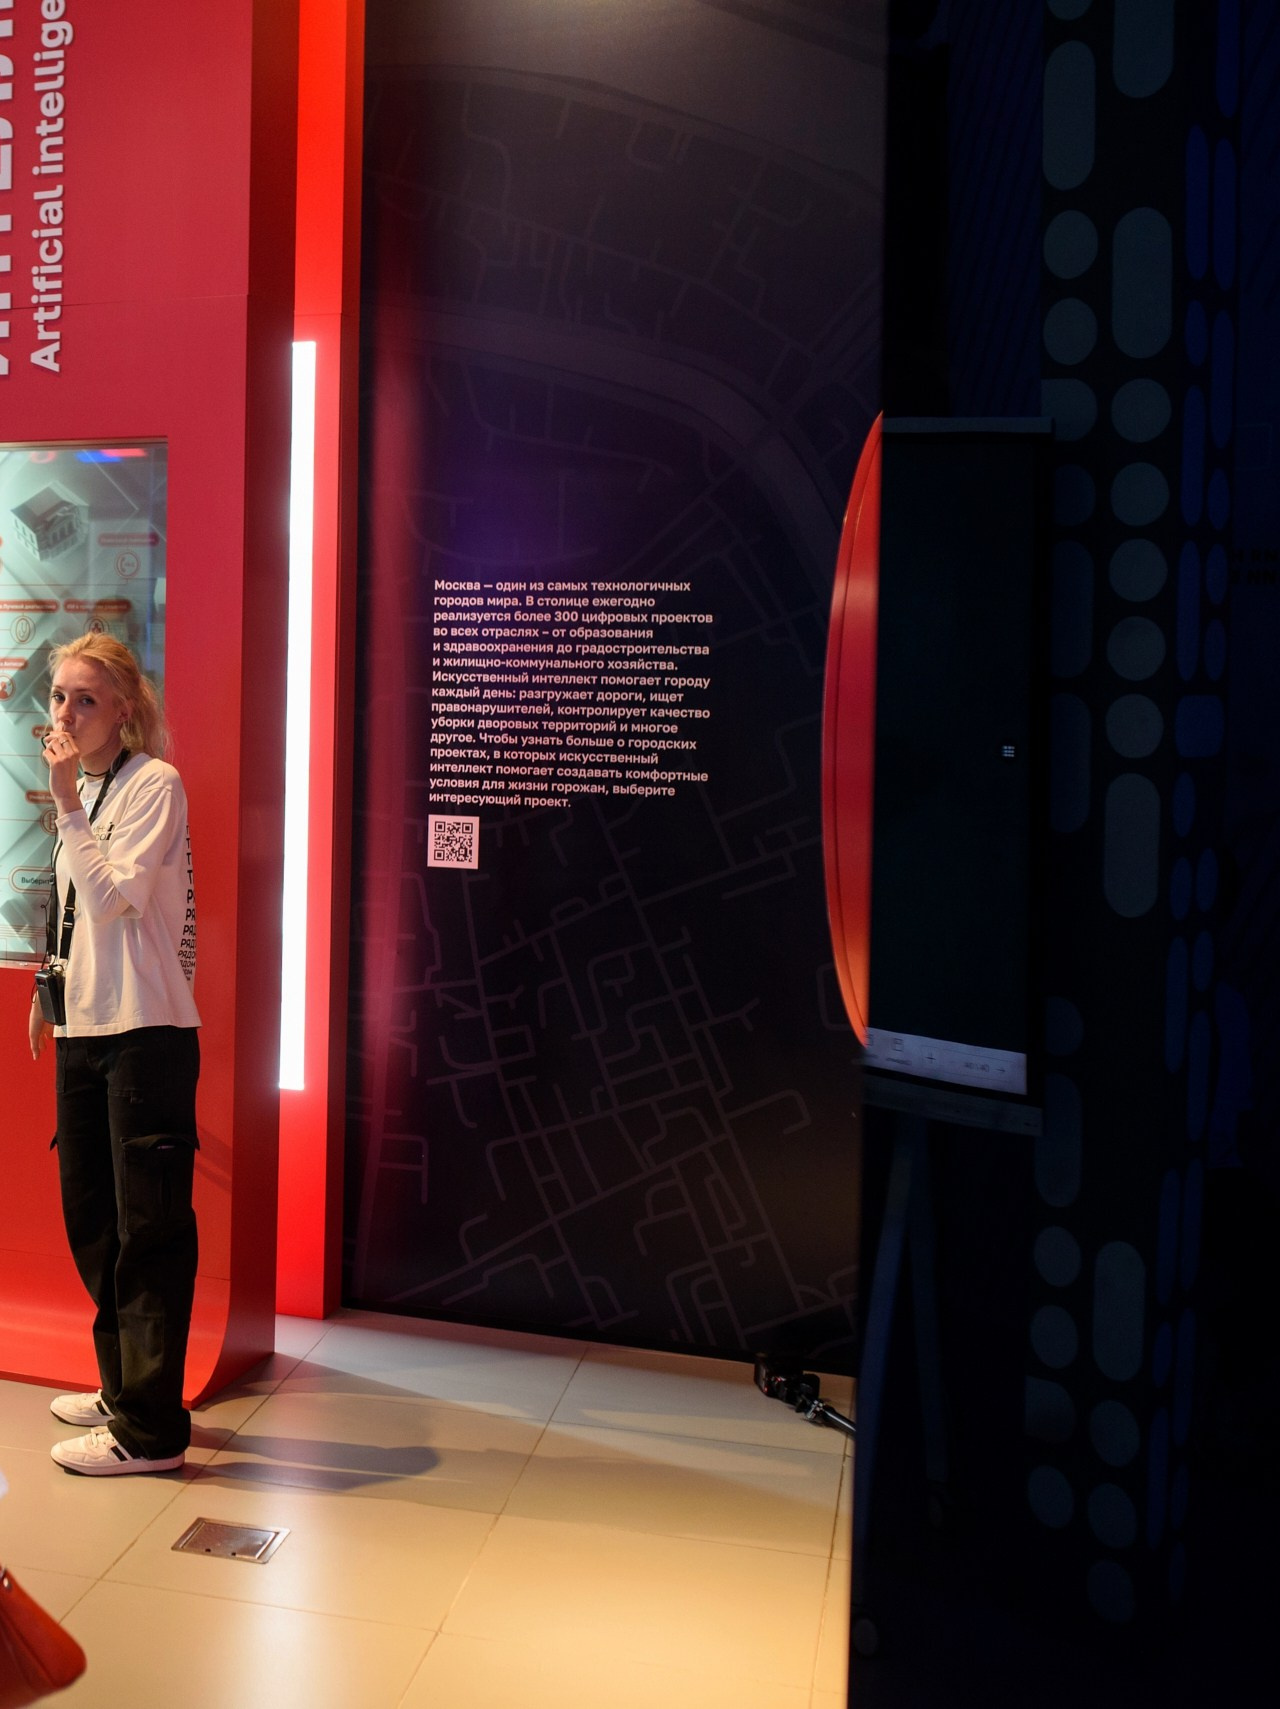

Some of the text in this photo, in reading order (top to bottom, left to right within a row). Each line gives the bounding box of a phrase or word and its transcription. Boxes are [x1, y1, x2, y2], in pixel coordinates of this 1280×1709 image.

[30, 0, 73, 372] Artificial intellige
[434, 579, 481, 591] Москва
[495, 581, 526, 592] один
[529, 581, 544, 591] из
[546, 582, 588, 591] самых
[590, 582, 690, 591] технологичных
[433, 595, 655, 609] городов мира. В столице ежегодно
[433, 610, 713, 625] реализуется более 300 цифровых проектов
[433, 627, 448, 636] во
[450, 627, 478, 636] всех
[481, 627, 539, 639] отраслях
[551, 628, 566, 637] от
[569, 626, 653, 640] образования
[432, 642, 709, 656] и здравоохранения до градостроительства
[432, 657, 678, 670] и жилищно-коммунального хозяйства.
[432, 670, 710, 689] Искусственный интеллект помогает городу
[431, 686, 684, 703] каждый день: разгружает дороги, ищет
[431, 702, 710, 719] правонарушителей, контролирует качество
[430, 716, 678, 734] уборки дворовых территорий и многое
[430, 732, 696, 750] другое. Чтобы узнать больше о городских
[430, 748, 658, 764] проектах, в которых искусственный
[429, 762, 708, 783] интеллект помогает создавать комфортные
[429, 777, 675, 798] условия для жизни горожан, выберите
[428, 792, 571, 808] интересующий проект.
[21, 876, 50, 886] Выберит
